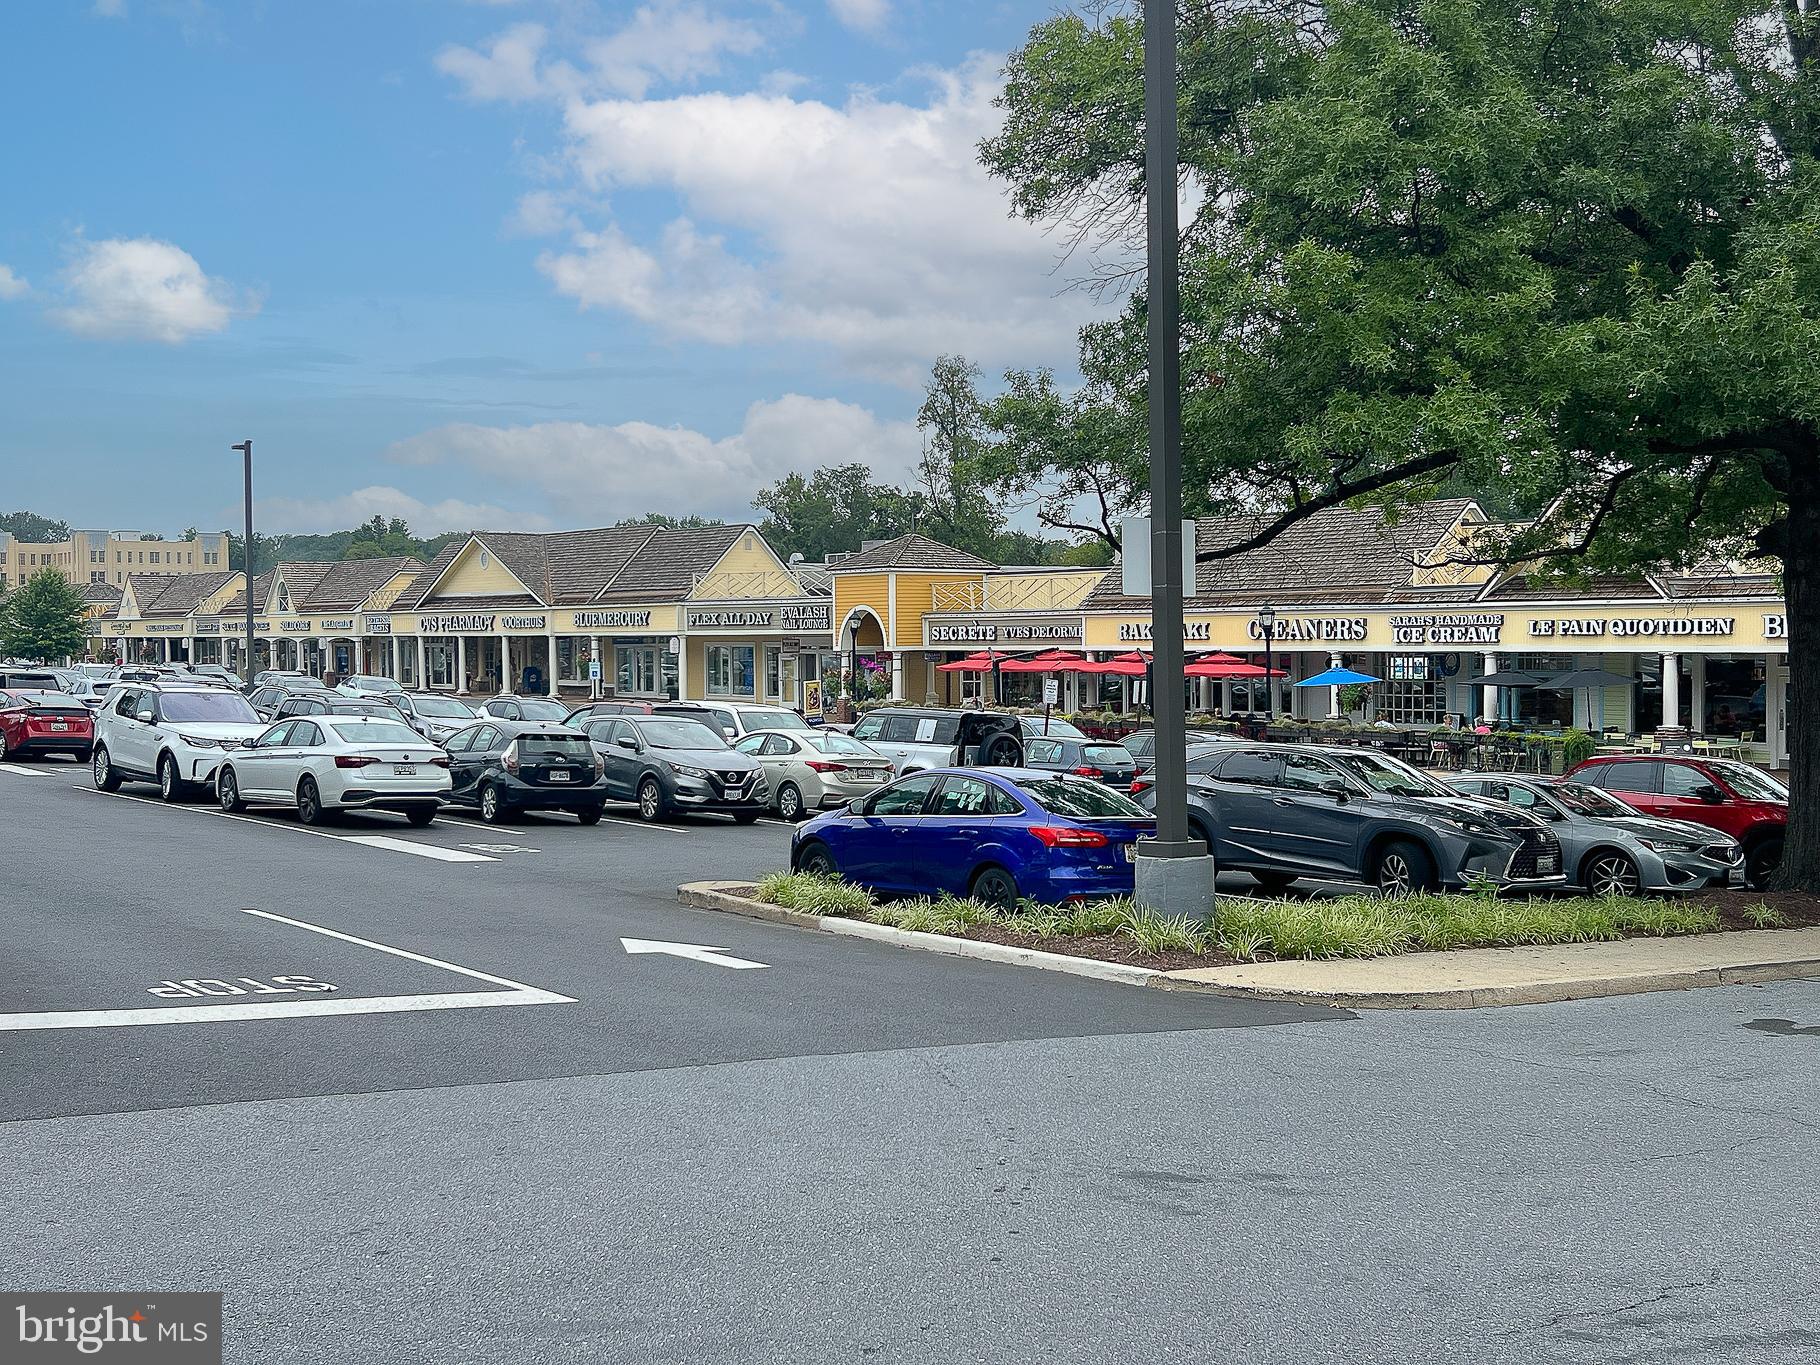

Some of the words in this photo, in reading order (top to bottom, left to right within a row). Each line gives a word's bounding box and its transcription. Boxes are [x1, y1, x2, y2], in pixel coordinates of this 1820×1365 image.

[573, 611, 650, 627] BLUEMERCURY
[688, 613, 719, 626] FLEX
[721, 613, 744, 625] ALL
[746, 612, 771, 625] DAY
[781, 607, 827, 618] EVALASH
[1389, 616, 1433, 626] SARAH'S
[1436, 615, 1503, 625] HANDMADE
[420, 617, 439, 632] CVS
[441, 615, 495, 631] PHARMACY
[781, 619, 799, 629] NAIL
[800, 618, 829, 629] LOUNGE
[931, 620, 995, 641] SECRÈTE
[1528, 620, 1554, 635] LE
[1557, 619, 1606, 635] PAIN
[1608, 618, 1734, 636] QUOTIDIEN
[1003, 626, 1030, 638] YVES
[1393, 628, 1424, 643] ICE
[1427, 627, 1499, 643] CREAM
[146, 975, 339, 998] STOP
